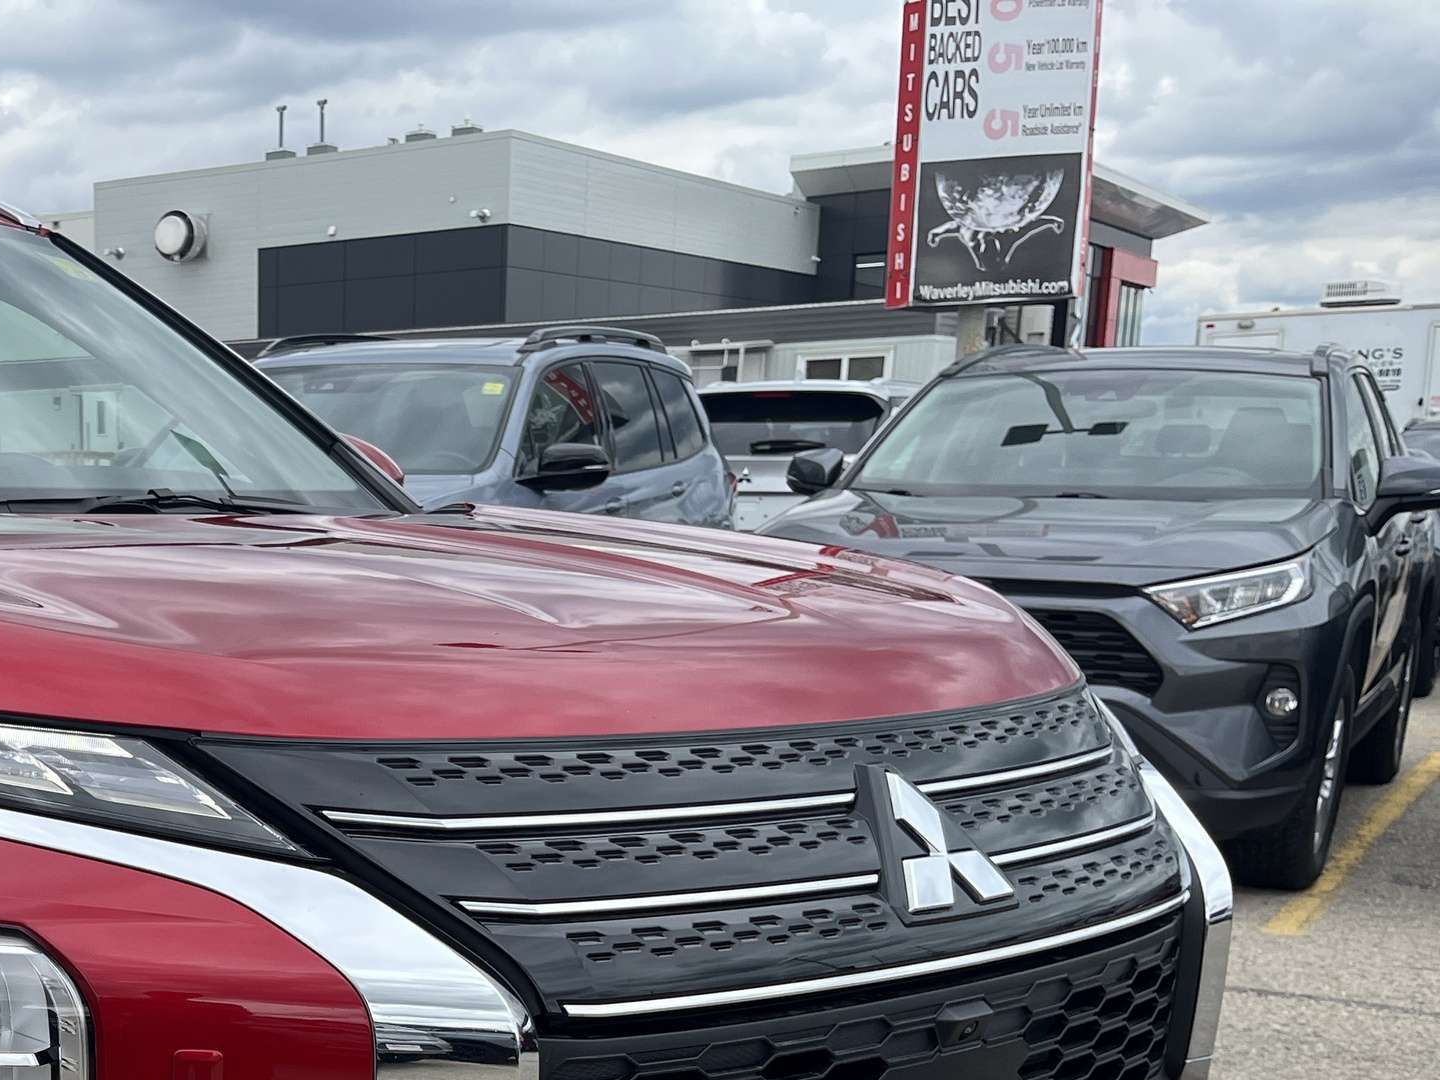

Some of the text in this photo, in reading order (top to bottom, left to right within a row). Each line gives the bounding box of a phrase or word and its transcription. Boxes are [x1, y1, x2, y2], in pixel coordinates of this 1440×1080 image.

[927, 30, 982, 65] BACKED
[1026, 39, 1045, 56] Year
[1076, 37, 1088, 53] km
[925, 67, 980, 121] CARS
[1023, 102, 1083, 119] Year Unlimited km
[894, 12, 920, 299] MITSUBISHI
[919, 278, 1069, 301] WaverleyMitsubishi.com
